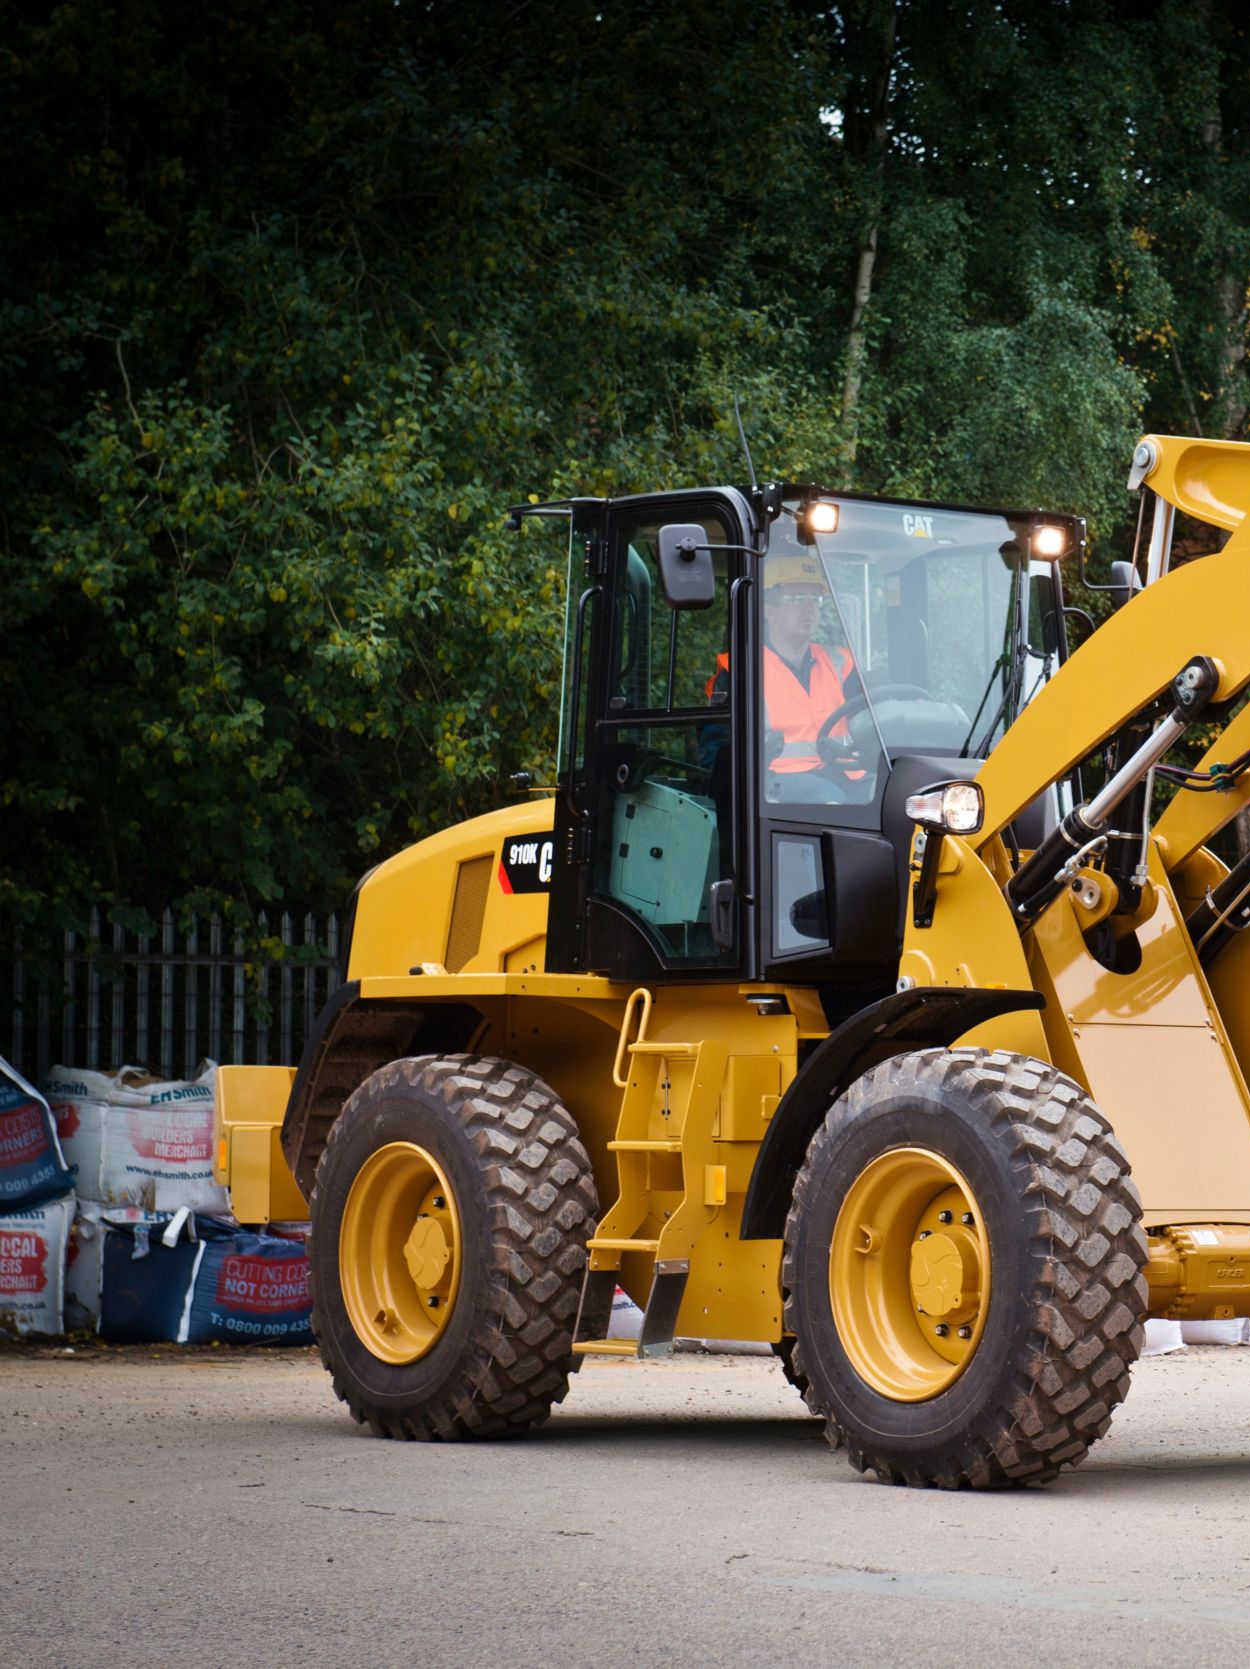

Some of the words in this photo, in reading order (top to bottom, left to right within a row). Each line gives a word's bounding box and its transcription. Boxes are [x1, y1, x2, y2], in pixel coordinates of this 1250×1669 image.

[903, 514, 933, 539] CAT
[509, 842, 539, 865] 910K
[154, 1142, 207, 1158] MERCHANT
[226, 1260, 282, 1284] CUTTING
[224, 1278, 258, 1297] NOT
[260, 1280, 306, 1299] CORNE
[226, 1318, 262, 1335] 0800
[263, 1322, 288, 1336] 009
[290, 1318, 310, 1332] 435
